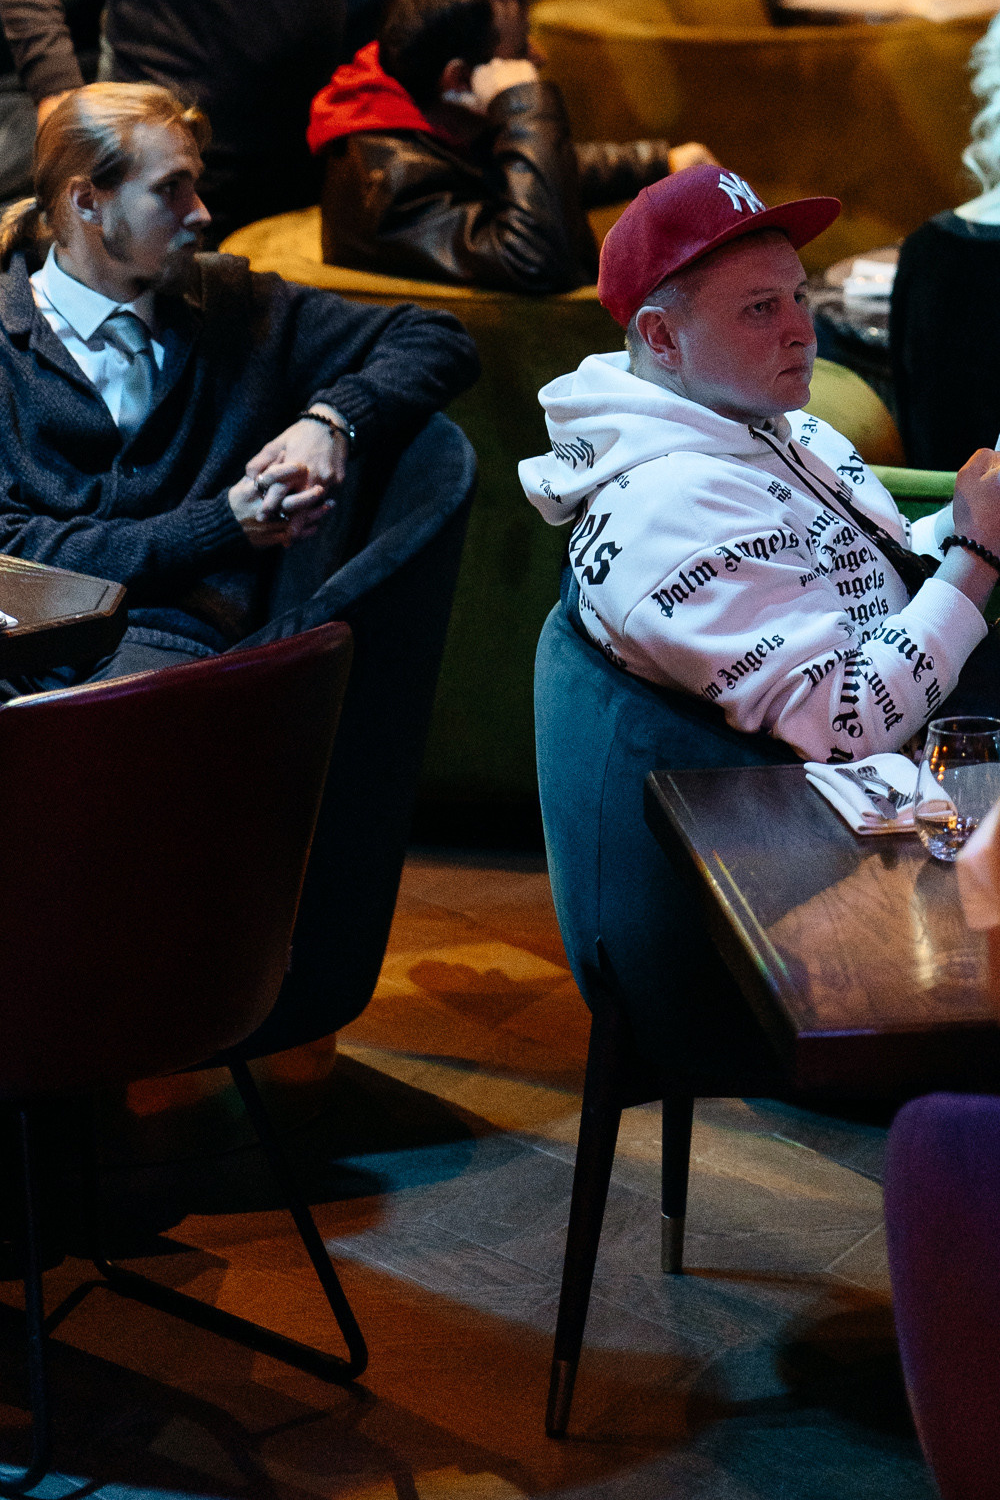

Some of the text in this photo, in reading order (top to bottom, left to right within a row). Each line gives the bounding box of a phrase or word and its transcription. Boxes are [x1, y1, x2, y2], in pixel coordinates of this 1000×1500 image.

[717, 171, 767, 214] NY
[714, 529, 800, 573] Angels
[717, 633, 786, 691] Angels
